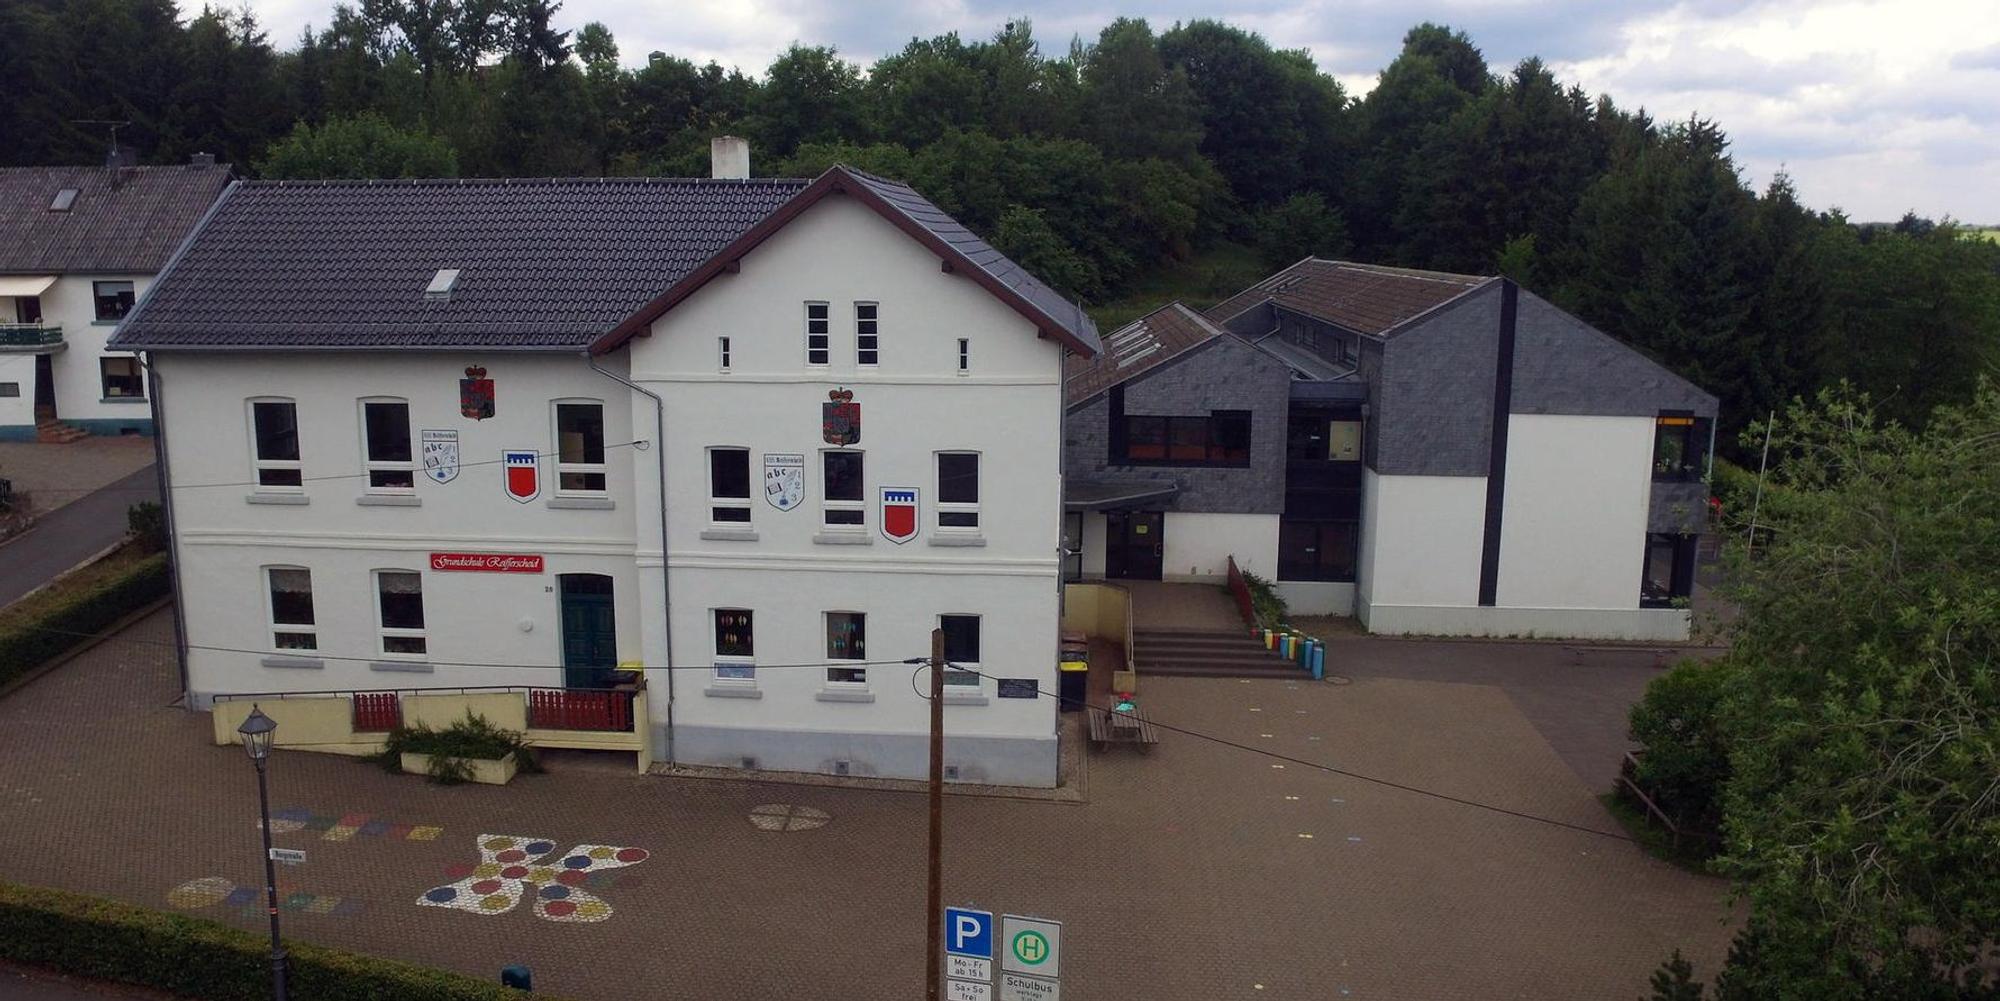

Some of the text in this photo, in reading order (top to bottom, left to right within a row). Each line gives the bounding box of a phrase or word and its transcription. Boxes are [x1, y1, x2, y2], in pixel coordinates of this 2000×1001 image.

[433, 555, 541, 570] Grundschule Reifferscheid
[956, 915, 981, 949] P
[1022, 937, 1039, 958] H
[968, 968, 978, 977] 15
[955, 983, 966, 991] Sa
[972, 985, 984, 994] So
[1007, 977, 1053, 993] Schulbus
